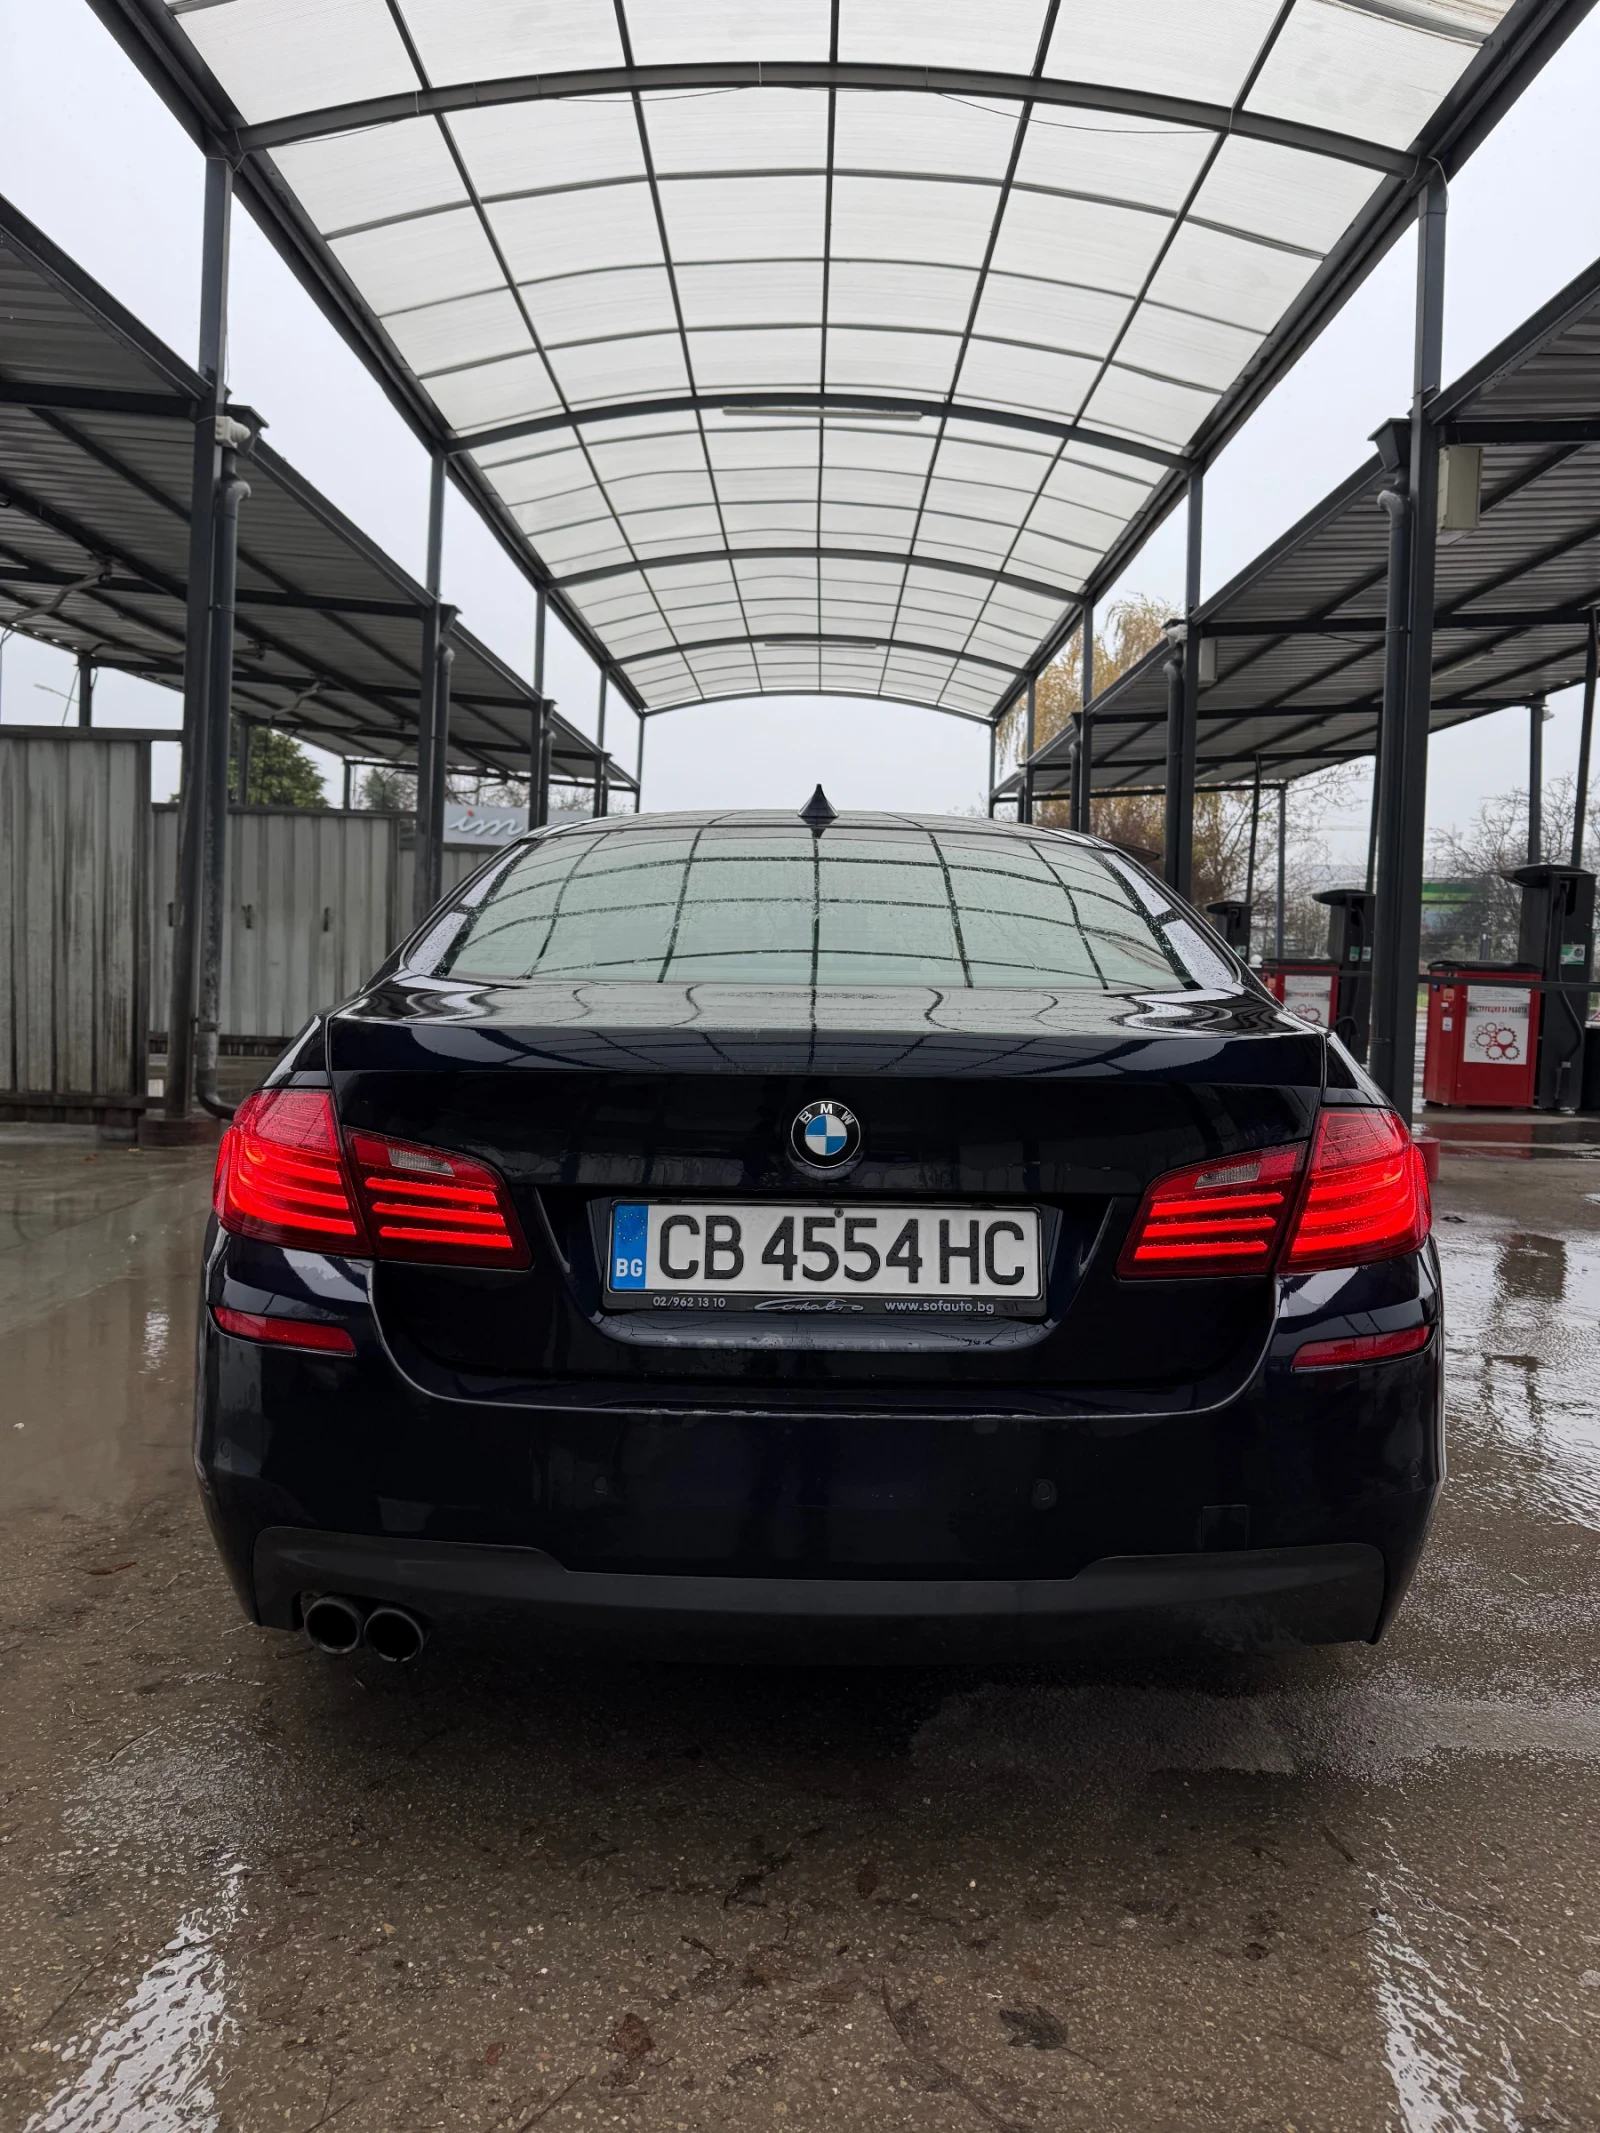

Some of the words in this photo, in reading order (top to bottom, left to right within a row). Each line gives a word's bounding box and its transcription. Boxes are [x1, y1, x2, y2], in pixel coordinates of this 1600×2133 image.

[799, 1103, 855, 1126] BMW
[659, 1214, 744, 1280] CB
[761, 1216, 923, 1284] 4554
[939, 1219, 1025, 1286] HC
[615, 1258, 643, 1278] BG
[652, 1296, 694, 1307] 02/962
[697, 1297, 709, 1307] 13
[712, 1297, 726, 1308] 10
[884, 1300, 995, 1314] www.sofauto.bg
